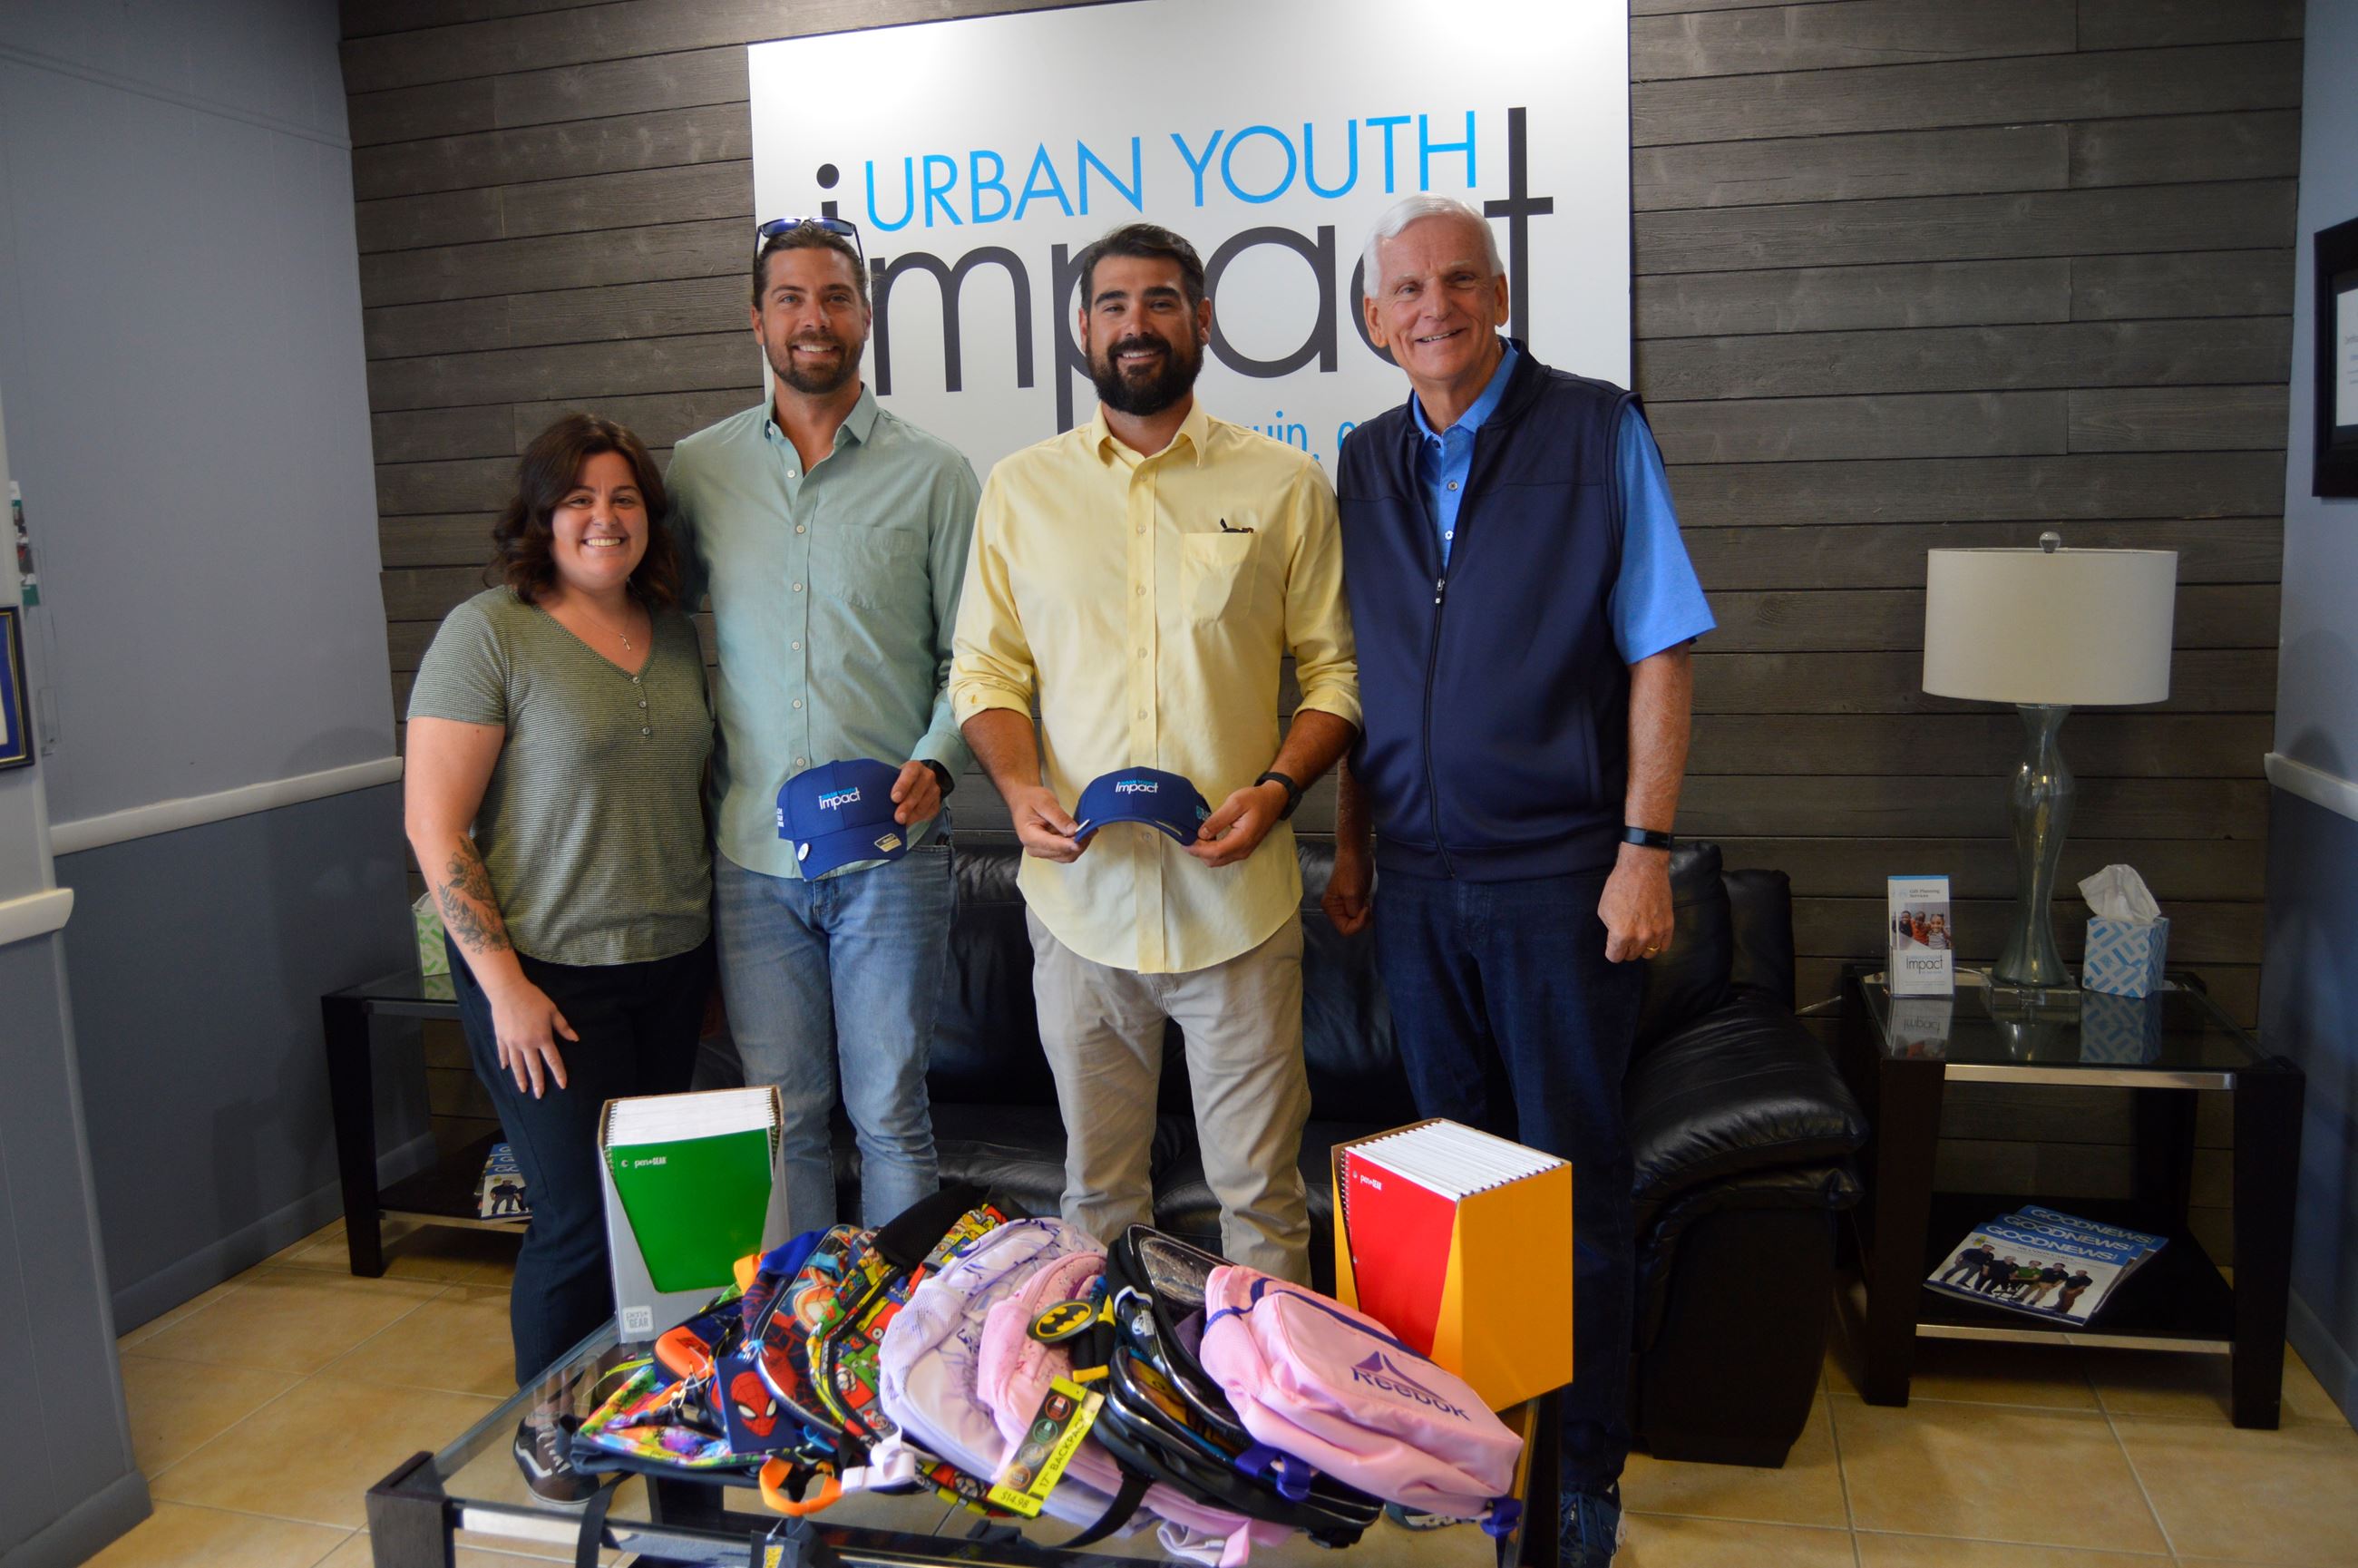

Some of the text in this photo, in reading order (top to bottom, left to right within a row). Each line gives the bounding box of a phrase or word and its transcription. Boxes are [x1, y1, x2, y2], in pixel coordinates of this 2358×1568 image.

[865, 111, 1477, 232] URBAN YOUTH
[816, 107, 1554, 435] mpat
[818, 786, 861, 811] impact
[1115, 781, 1158, 794] impact
[1905, 955, 1943, 974] impact
[1000, 1491, 1030, 1509] $14.98
